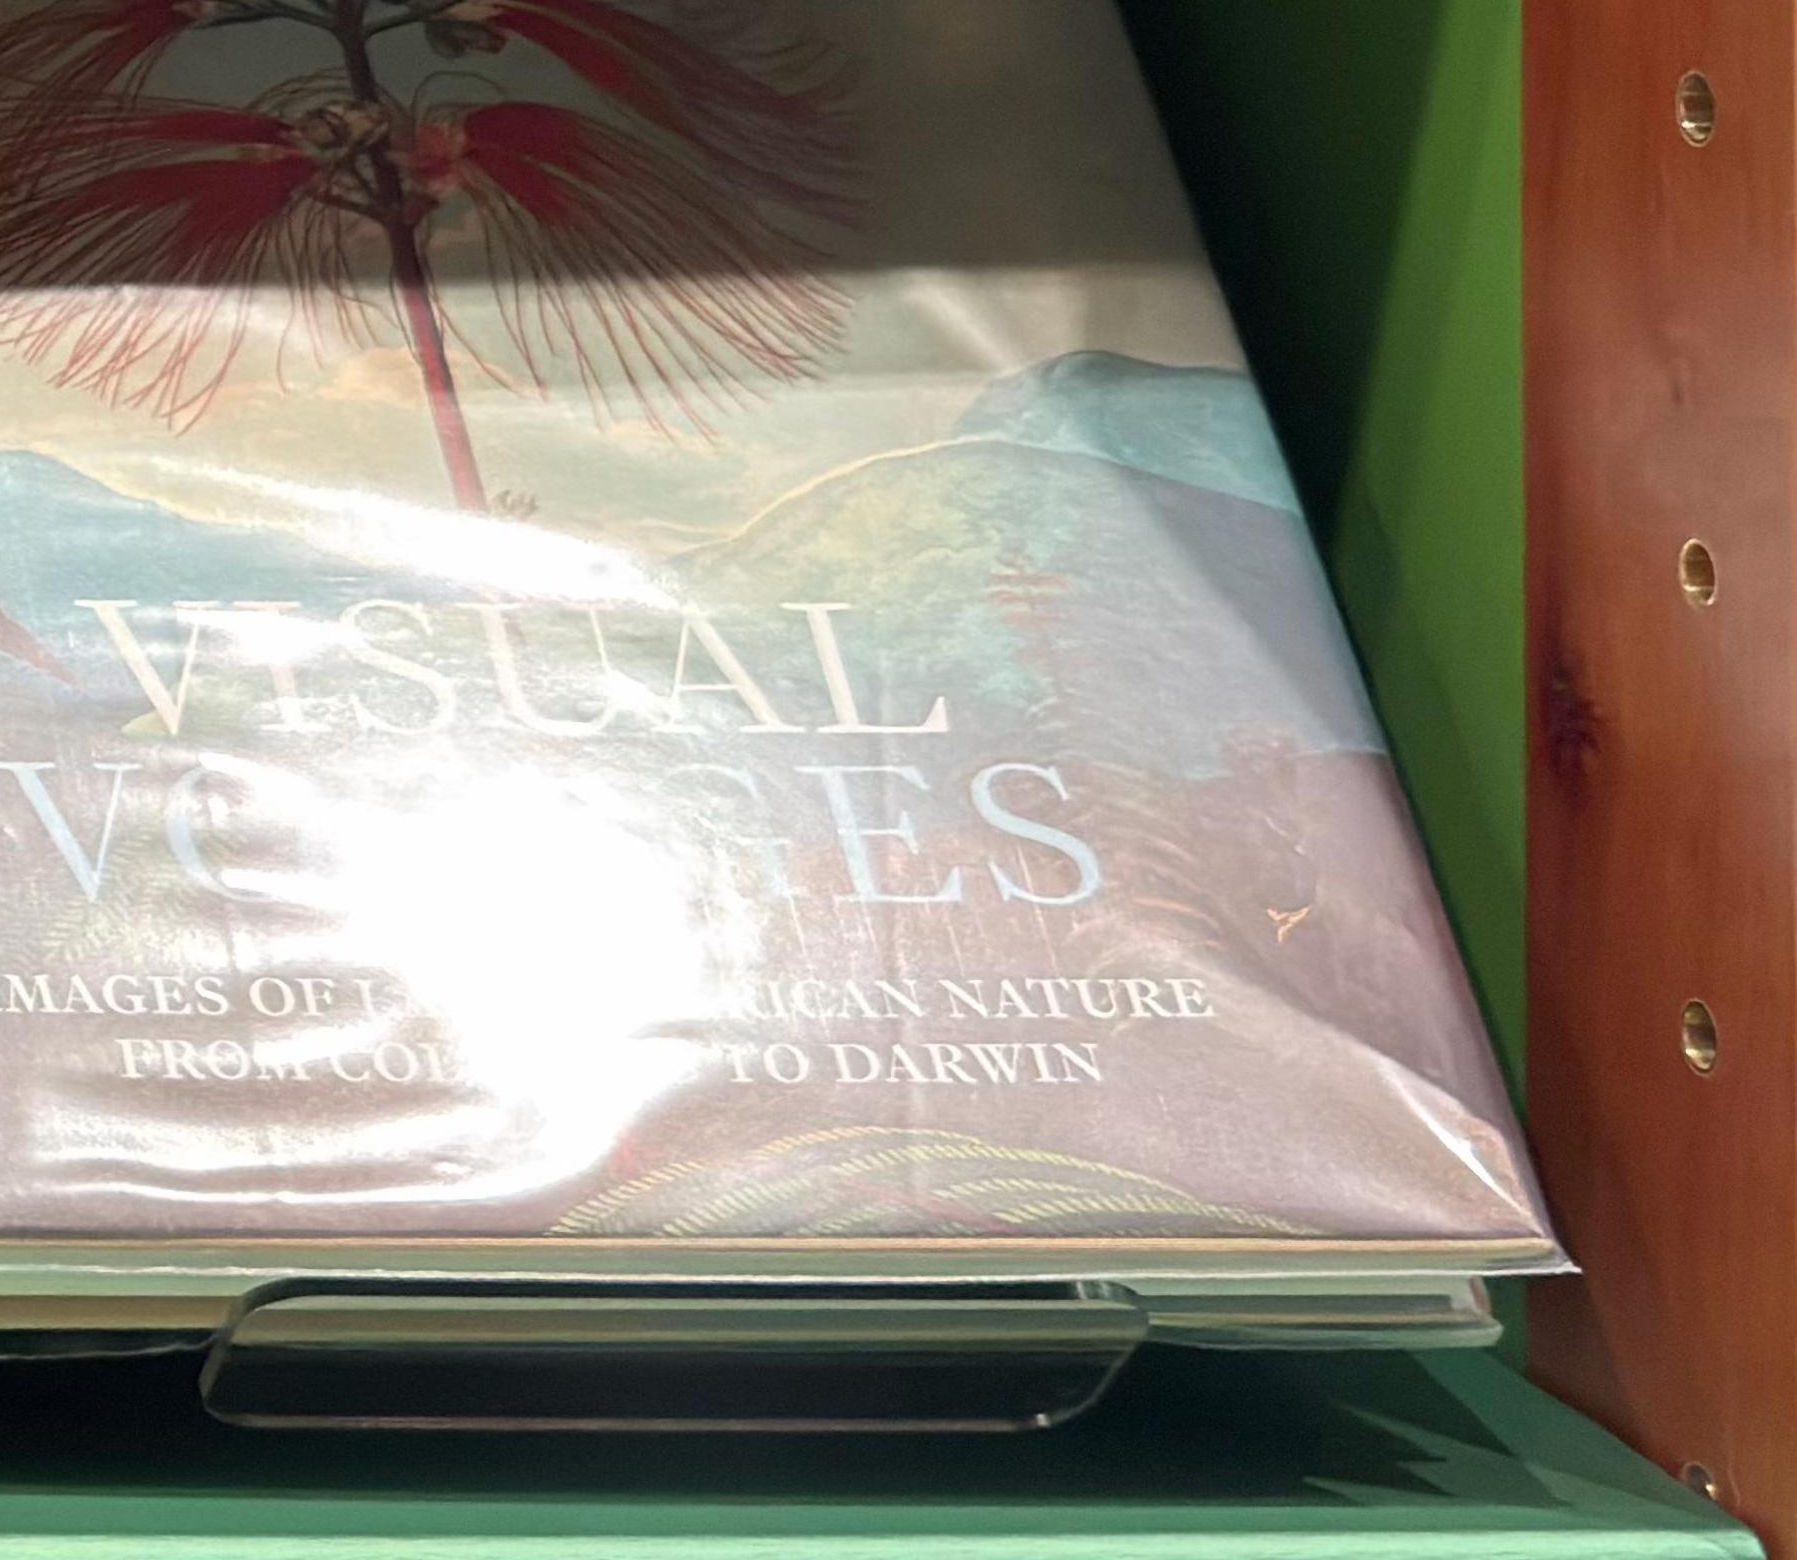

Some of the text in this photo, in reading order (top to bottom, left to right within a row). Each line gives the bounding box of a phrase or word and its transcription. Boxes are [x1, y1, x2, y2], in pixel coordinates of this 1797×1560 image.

[73, 596, 951, 737] VISUAL
[248, 976, 336, 1017] OF
[938, 977, 1216, 1020] NATURE
[115, 1038, 313, 1081] FROM
[724, 1042, 1102, 1084] TO DARWIN
